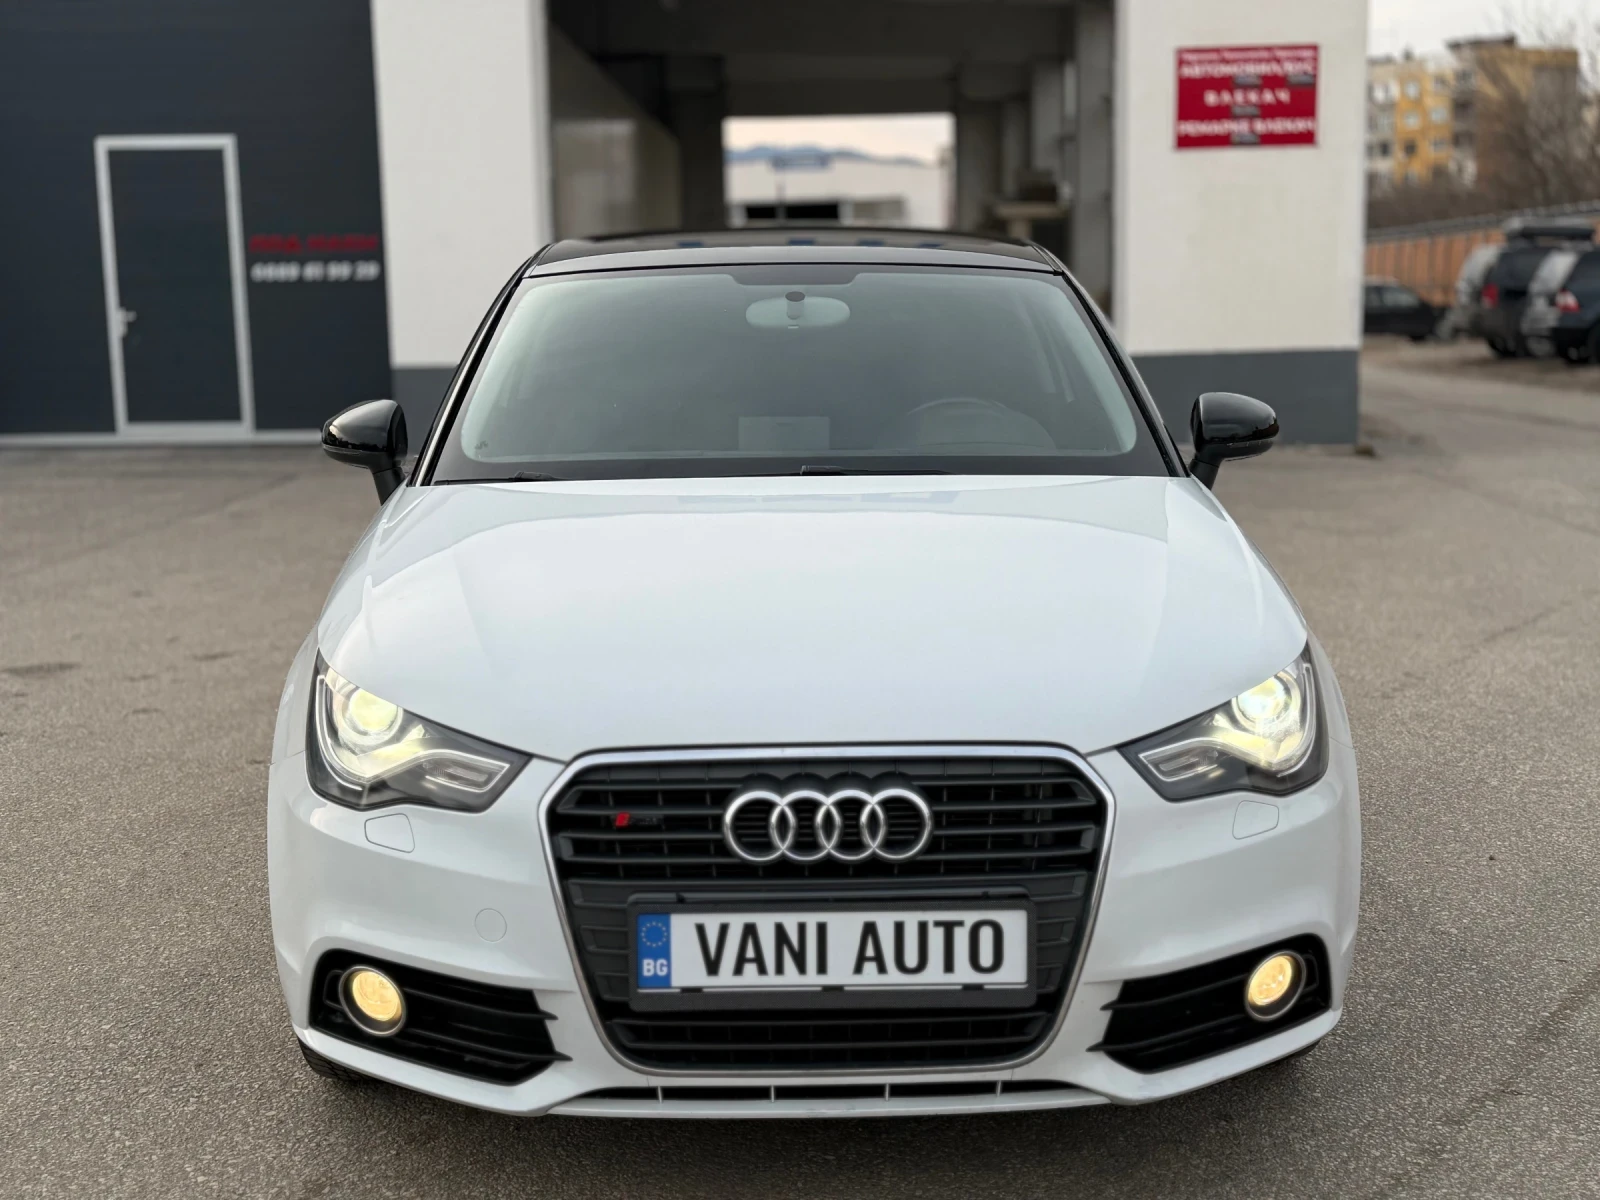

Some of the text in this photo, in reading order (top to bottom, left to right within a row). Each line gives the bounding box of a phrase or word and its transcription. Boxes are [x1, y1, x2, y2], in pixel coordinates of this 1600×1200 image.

[694, 919, 1004, 977] VANI AUTO
[643, 959, 668, 977] BG
